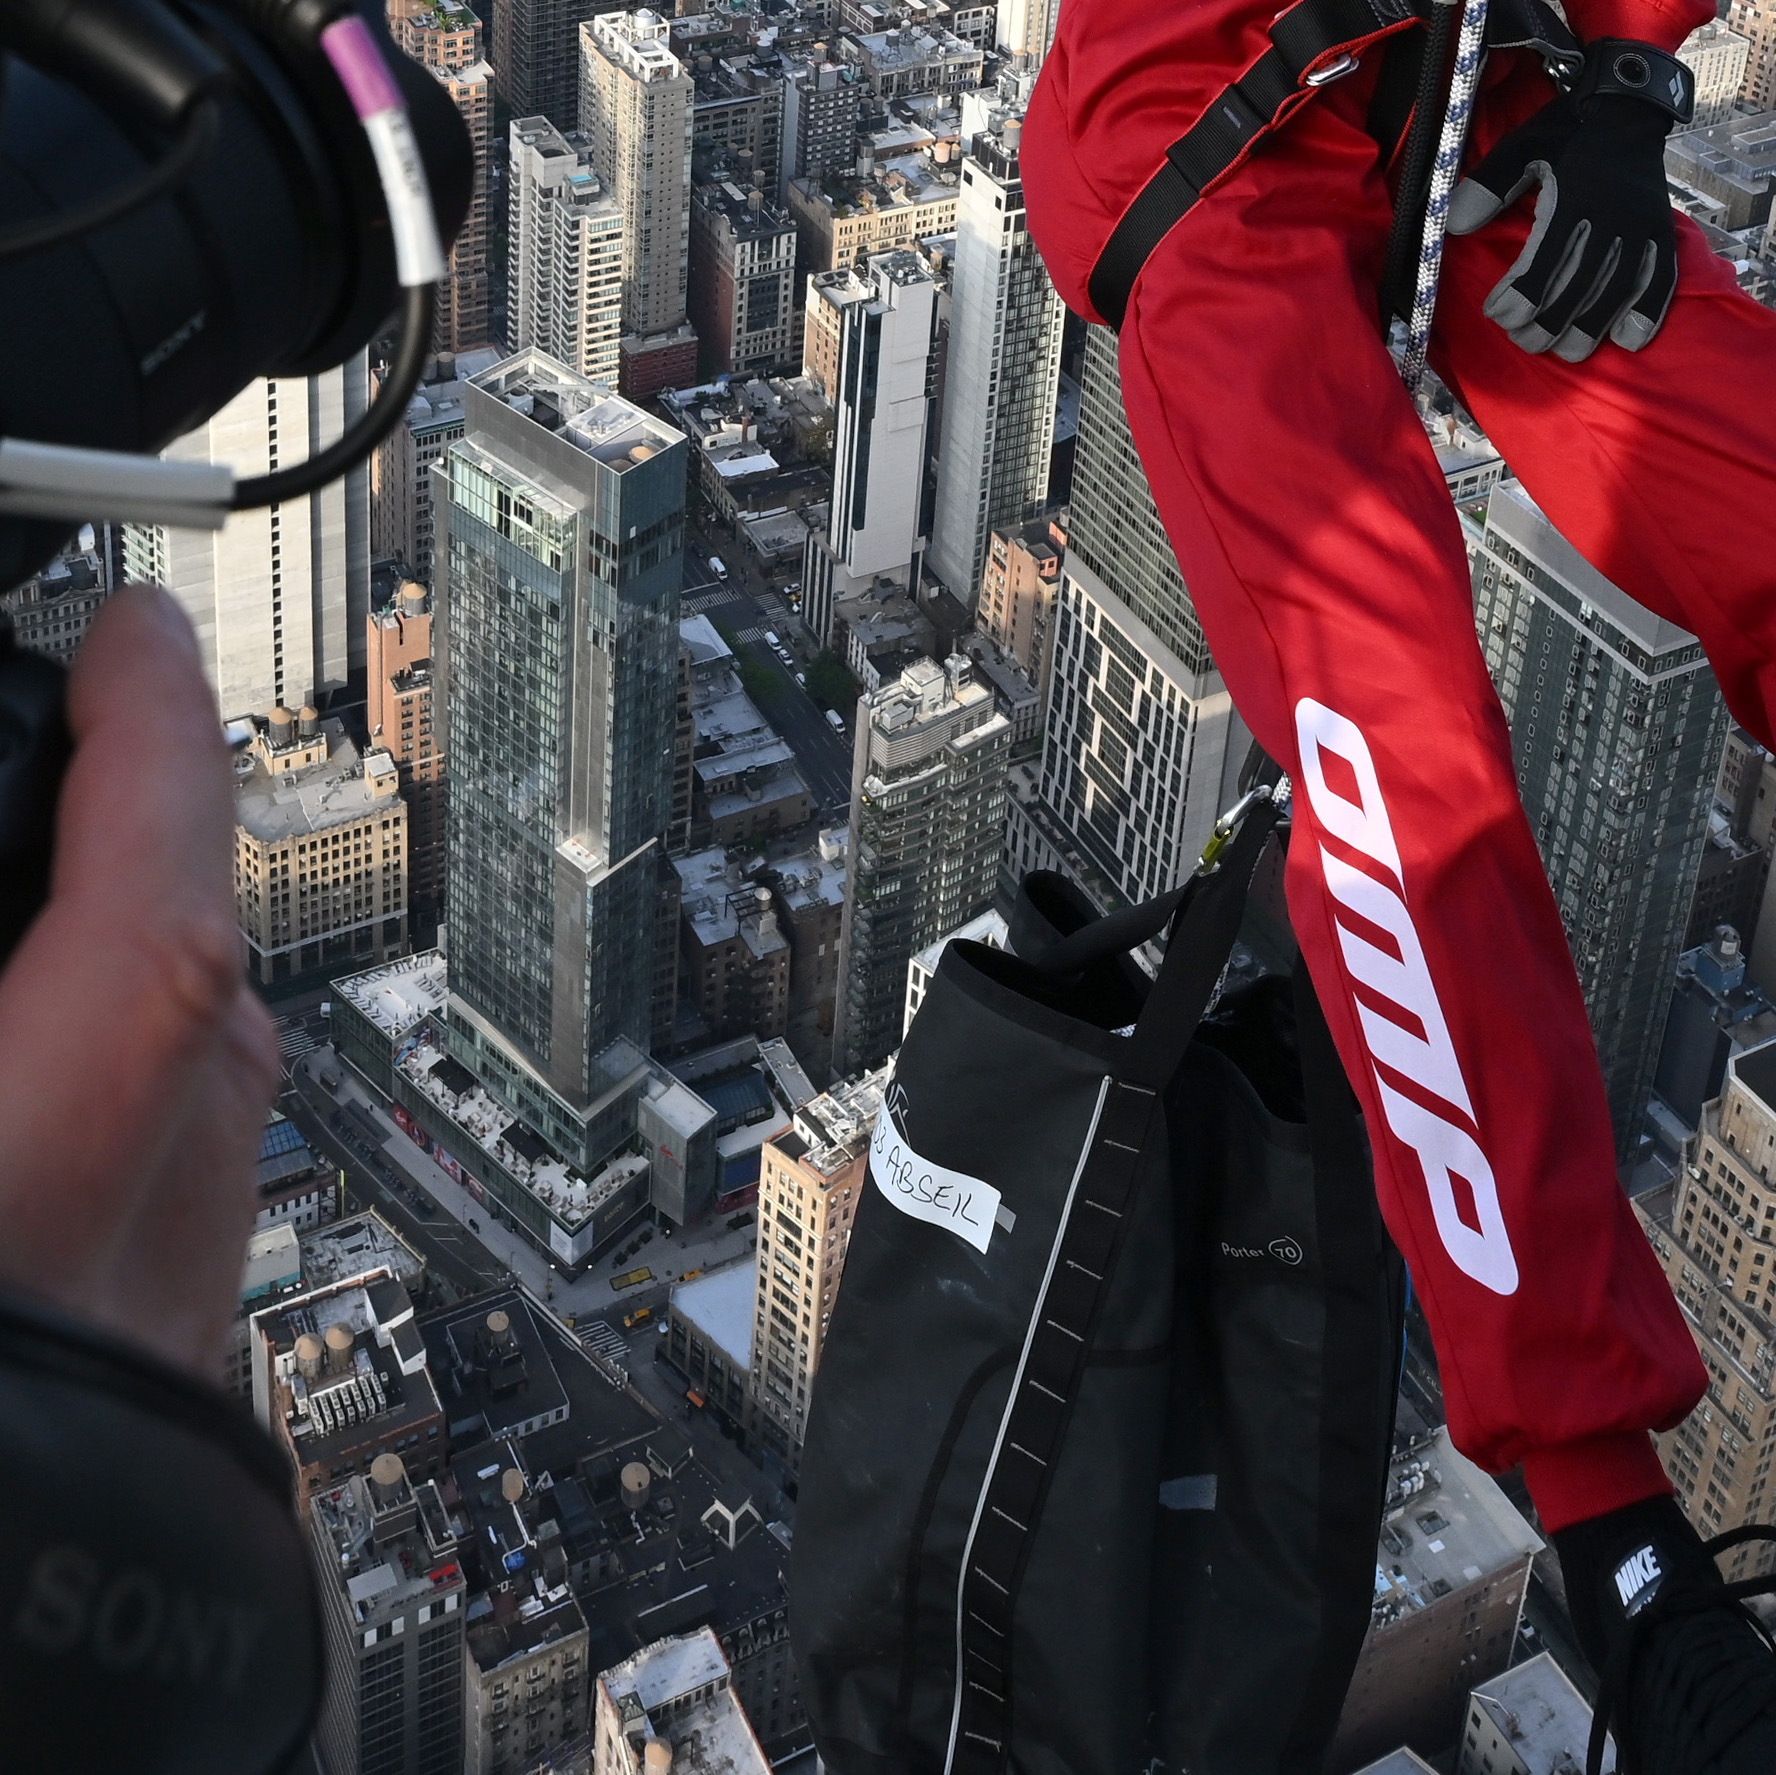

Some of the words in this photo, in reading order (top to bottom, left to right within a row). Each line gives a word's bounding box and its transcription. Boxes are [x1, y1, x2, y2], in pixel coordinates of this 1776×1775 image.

[1294, 696, 1520, 1296] OMP
[885, 1145, 979, 1227] ABSEIL
[1221, 1242, 1266, 1258] Porter
[1274, 1246, 1298, 1259] 70
[1614, 1544, 1662, 1607] NIKE
